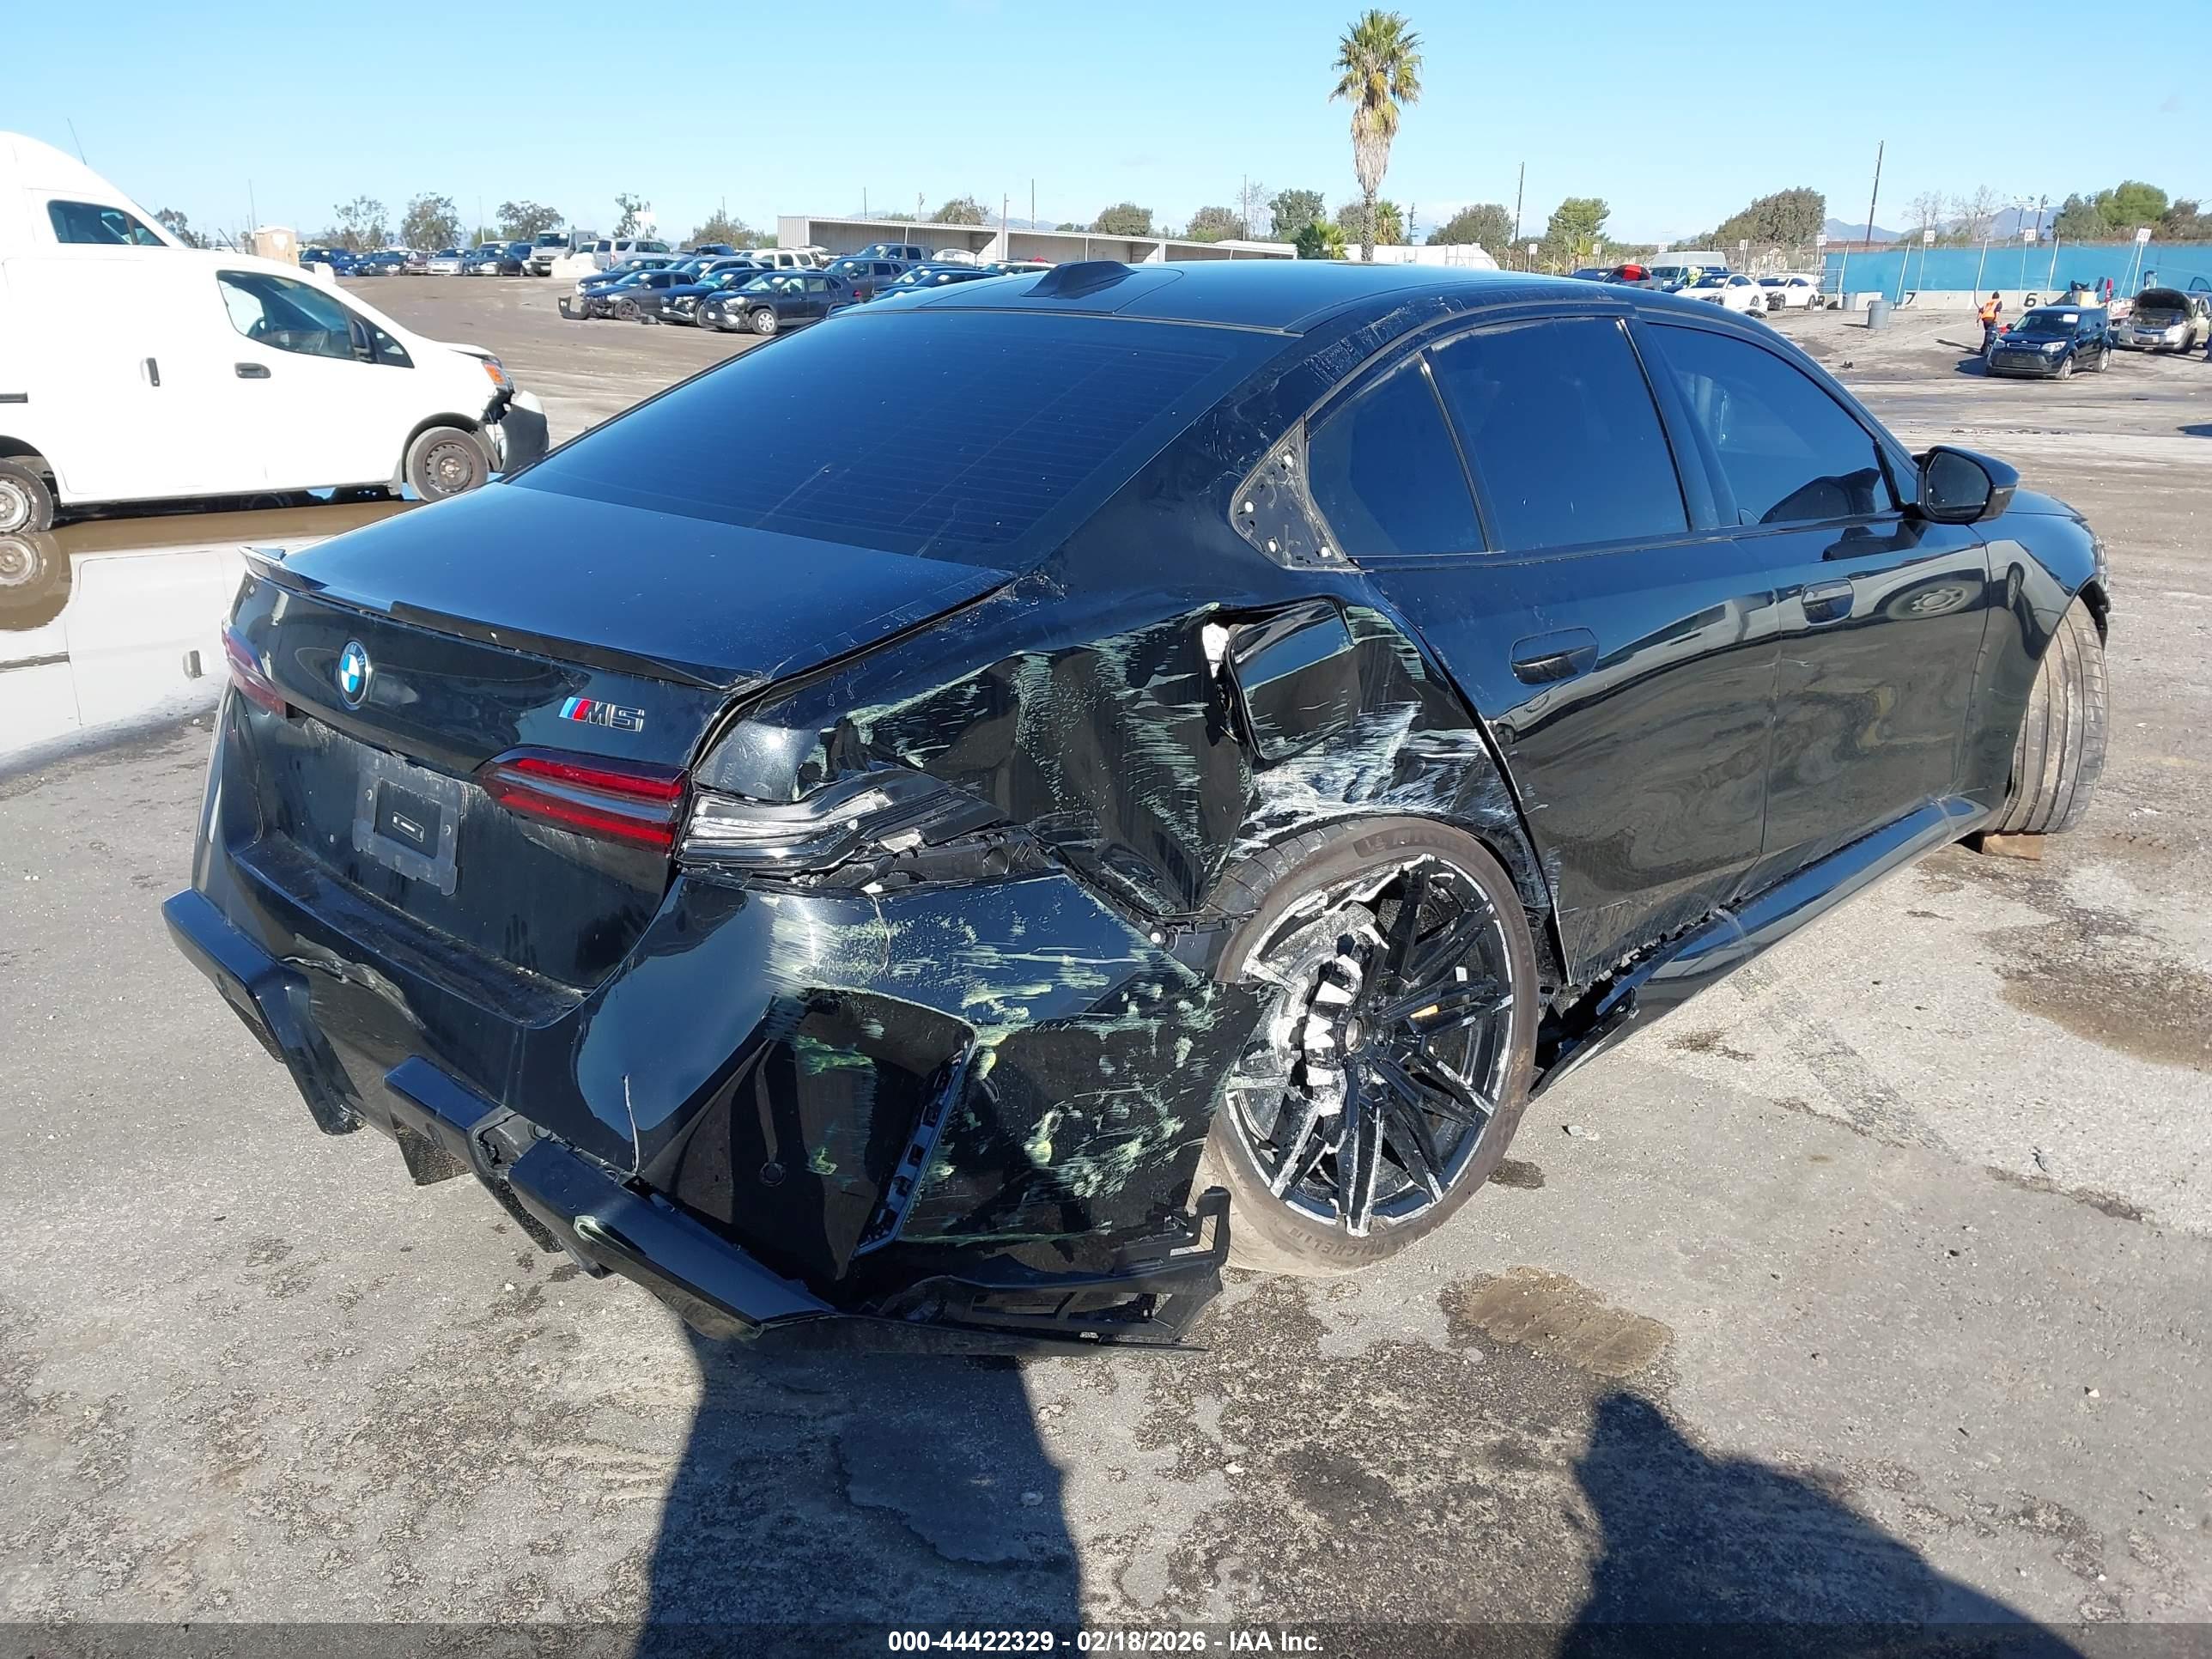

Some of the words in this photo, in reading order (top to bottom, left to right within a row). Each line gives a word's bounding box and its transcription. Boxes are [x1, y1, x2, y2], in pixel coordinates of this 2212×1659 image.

[1925, 232, 1935, 240] 22
[2026, 231, 2035, 240] 21
[2137, 230, 2150, 240] 20
[1905, 292, 1917, 305] 7
[2023, 292, 2039, 307] 6
[583, 700, 646, 732] M5
[1288, 1227, 1387, 1256] MICHELIN
